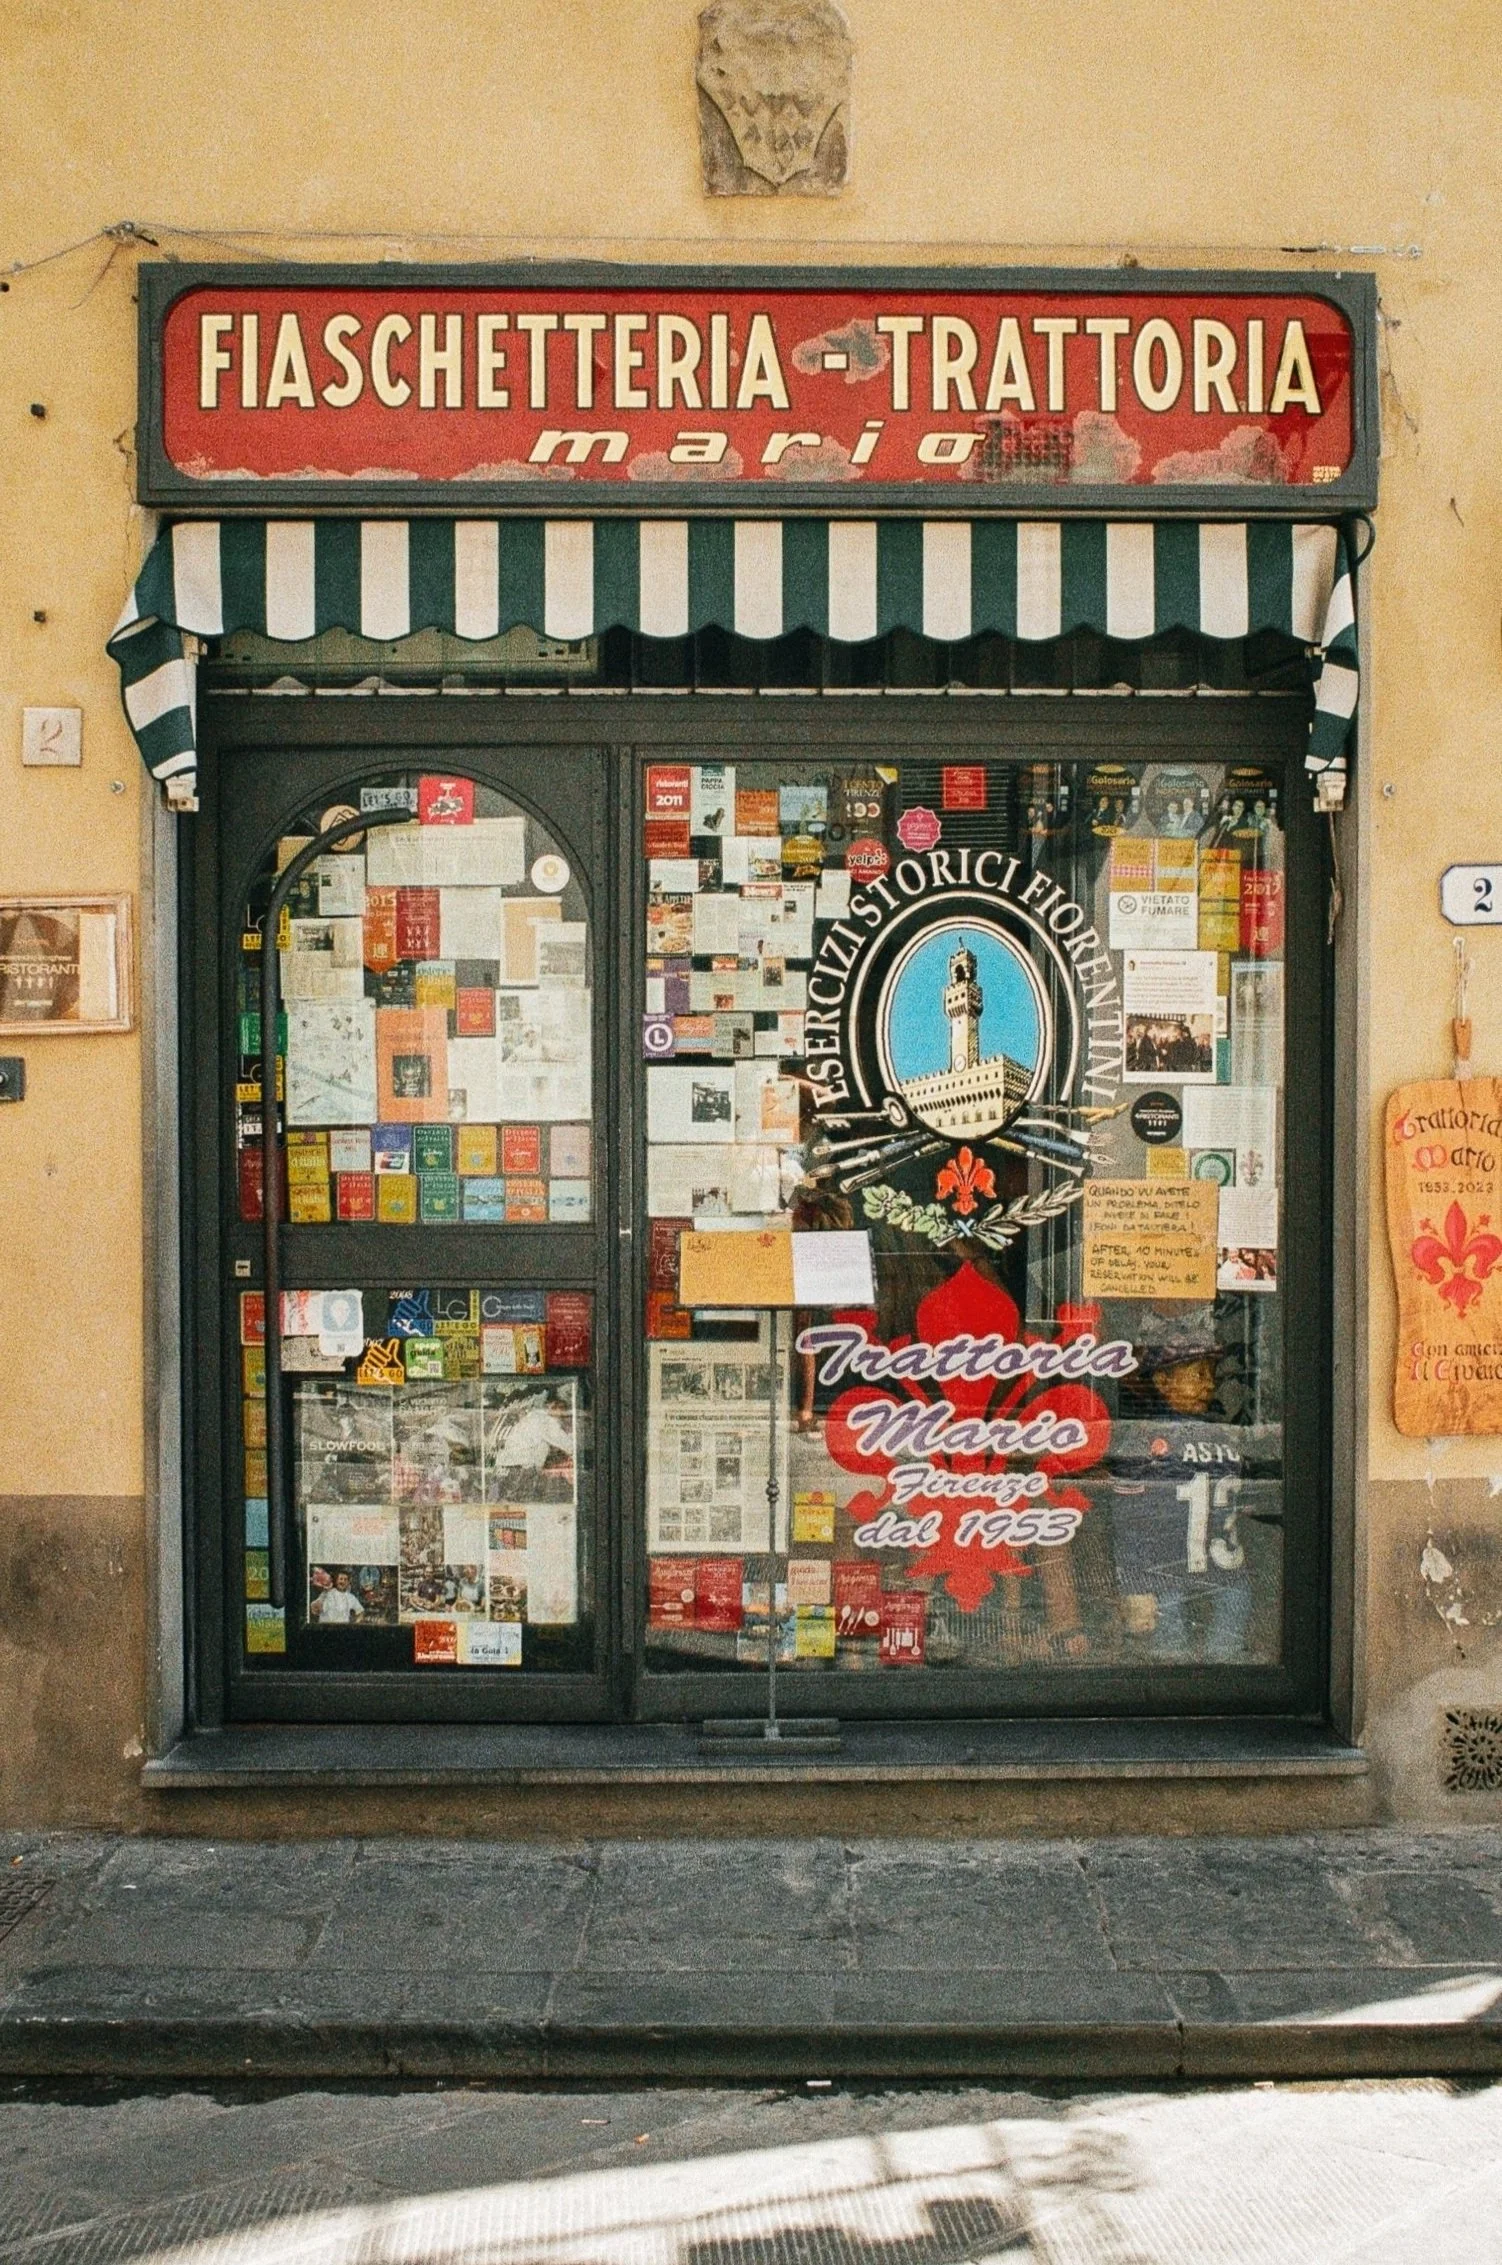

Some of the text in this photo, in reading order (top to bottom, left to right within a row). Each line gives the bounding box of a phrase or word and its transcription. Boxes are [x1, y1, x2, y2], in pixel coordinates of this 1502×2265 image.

[201, 311, 790, 412] FIASCHETTERIA
[877, 314, 1321, 414] TRATTORIA
[528, 421, 986, 464] mario
[40, 719, 62, 753] 2
[656, 795, 683, 806] 2011
[849, 855, 876, 866] yelp
[1141, 896, 1190, 905] VIETATO
[1141, 906, 1190, 915] FUMARE
[1473, 878, 1493, 912] 2
[804, 848, 1125, 1107] ESERCIZI STORICI FIORENTINI
[1412, 1144, 1496, 1173] Mario
[1088, 1185, 1134, 1198] QUANDO
[1136, 1246, 1151, 1256] 10
[795, 1324, 1138, 1386] Trattoria
[847, 1399, 1088, 1456] Mario
[887, 1463, 1049, 1507] Firenze
[853, 1511, 943, 1548] dal
[954, 1506, 1084, 1548] 1953
